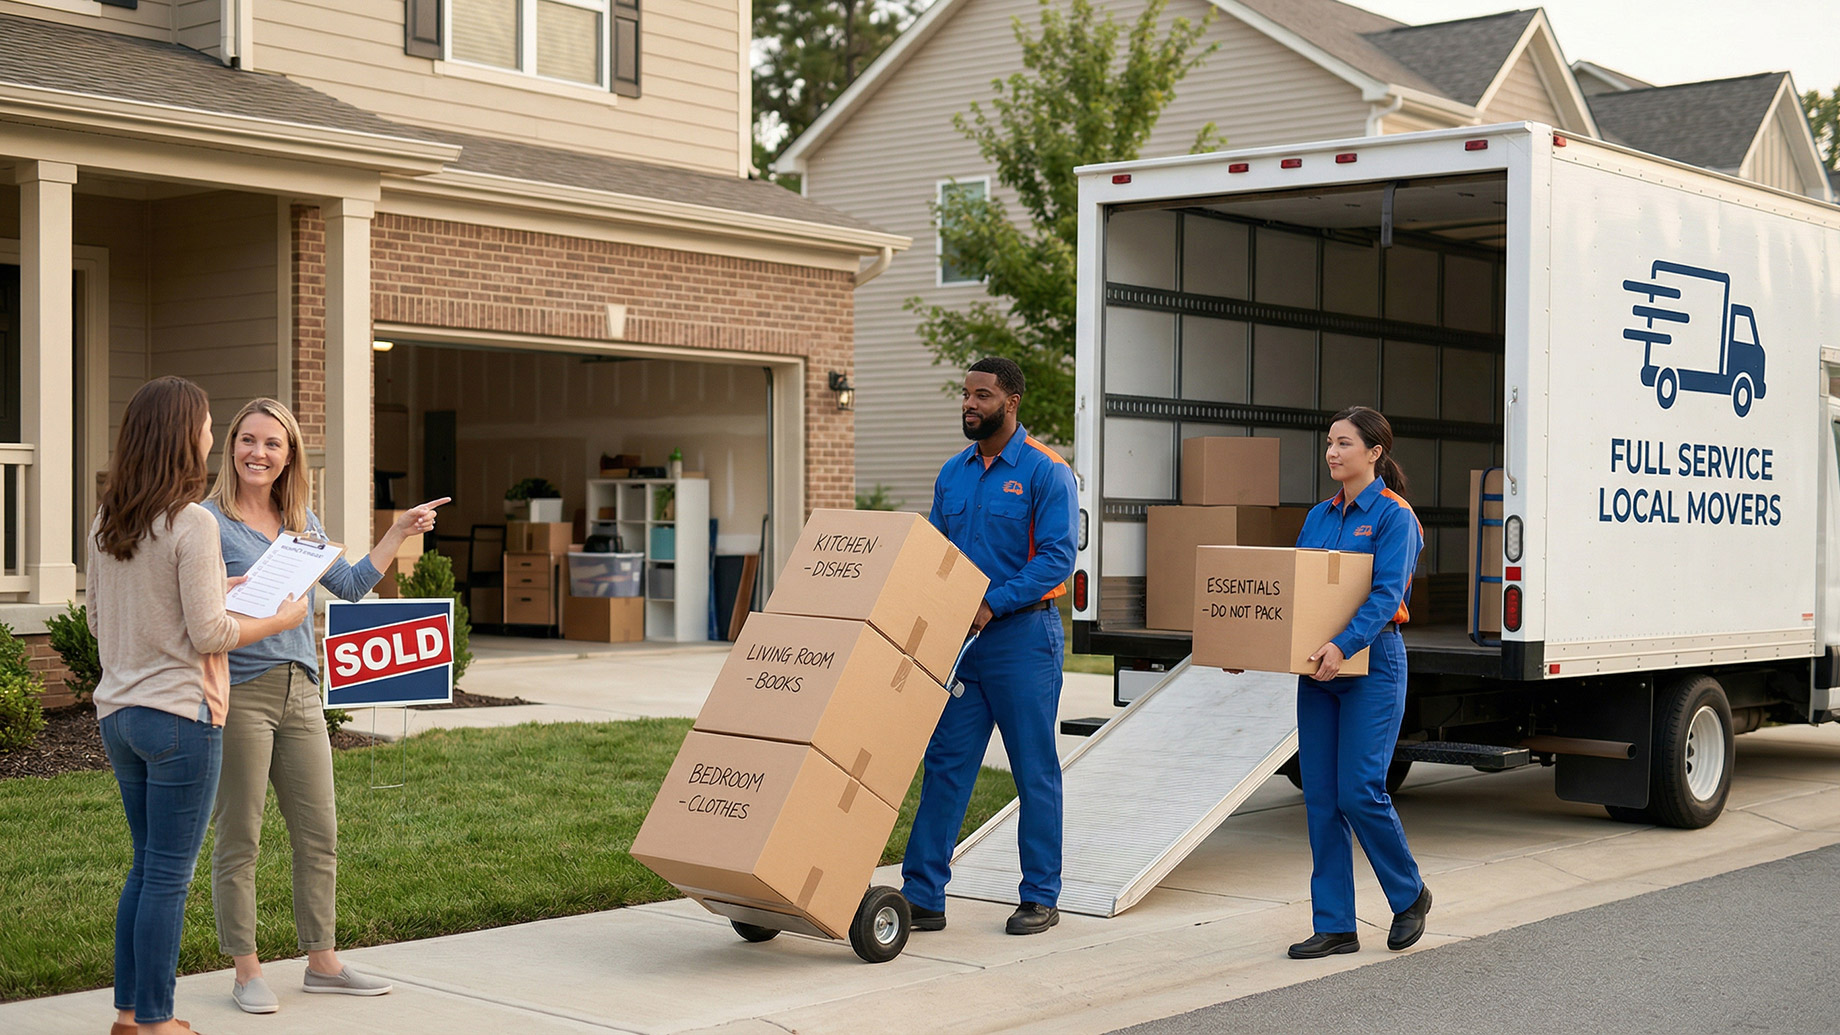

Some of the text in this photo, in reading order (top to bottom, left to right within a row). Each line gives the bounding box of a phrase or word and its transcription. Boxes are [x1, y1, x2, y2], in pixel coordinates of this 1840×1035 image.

[1610, 437, 1774, 481] FULL SERVICE
[1598, 487, 1782, 526] LOCAL MOVERS
[812, 534, 879, 553] KITCHEN
[1207, 577, 1280, 595] ESSENTIALS
[1230, 605, 1251, 618] NOT
[1255, 605, 1282, 620] PACK
[334, 626, 444, 678] SOLD
[746, 643, 836, 669] LIVING ROOM
[688, 762, 766, 793] BEDROOM
